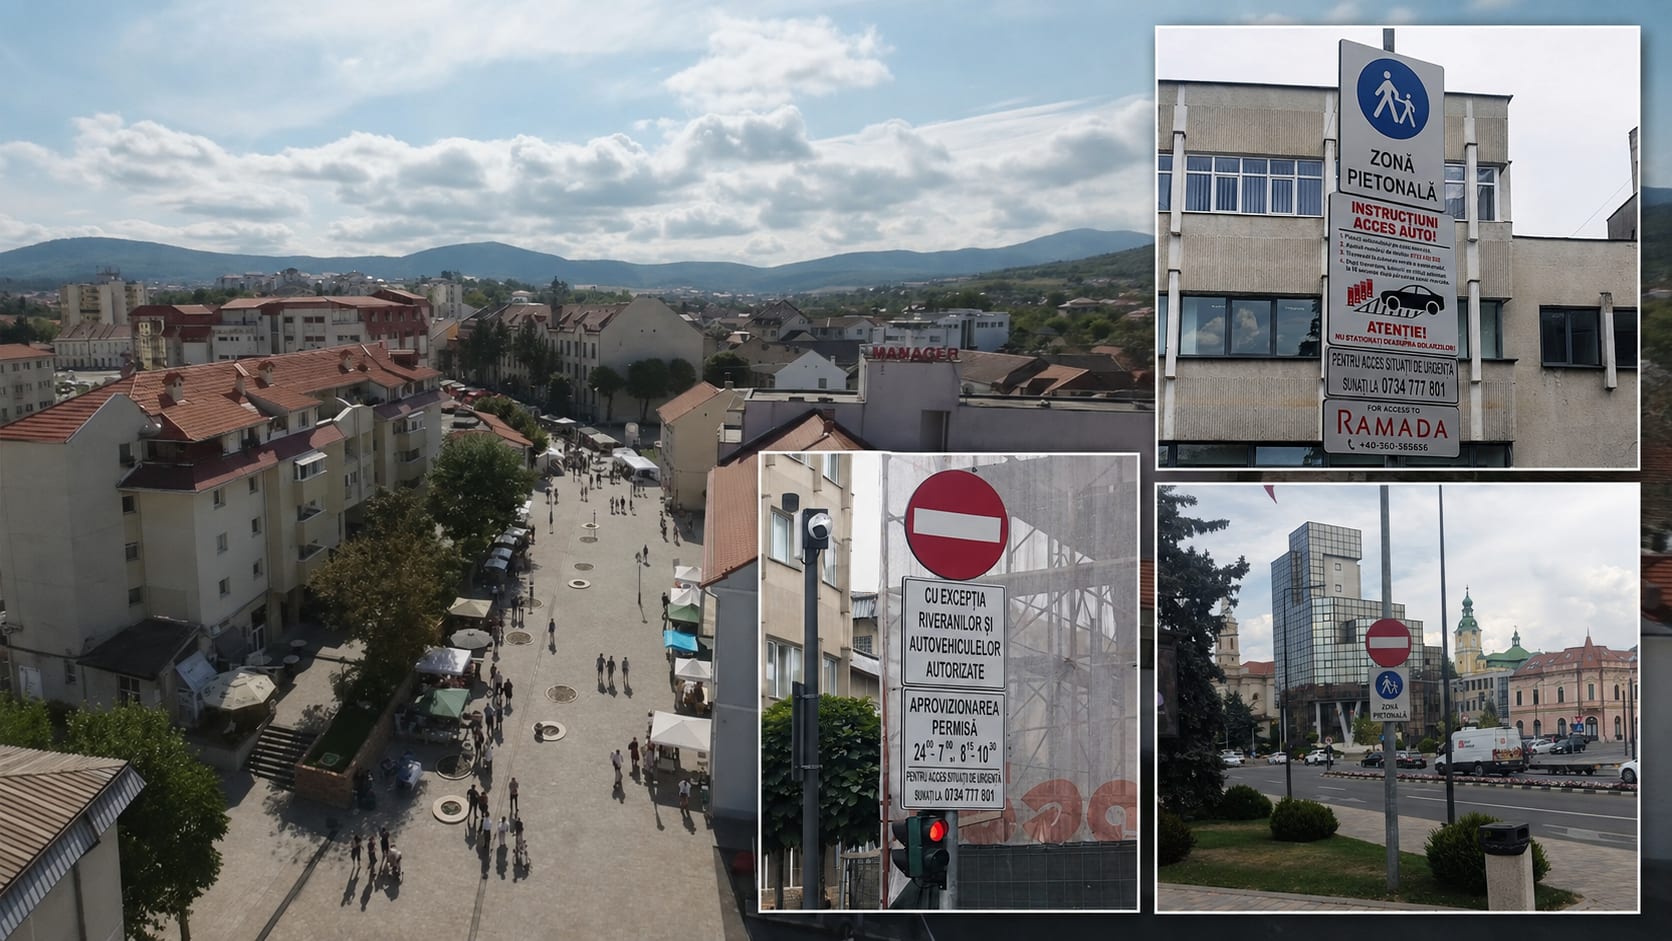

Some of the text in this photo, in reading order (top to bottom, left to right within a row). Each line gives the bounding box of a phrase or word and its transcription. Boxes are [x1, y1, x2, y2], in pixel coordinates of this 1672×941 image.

[1370, 149, 1415, 174] ZONĂ
[1347, 168, 1438, 202] PIETONALĂ
[1353, 216, 1437, 242] ACCES AUTO!
[1366, 320, 1427, 339] ATENȚIE!
[872, 346, 959, 360] MANAGER
[1331, 352, 1361, 368] PENTRU
[1361, 356, 1384, 370] ACCES
[1413, 361, 1423, 374] DE
[1370, 380, 1379, 393] LA
[1381, 378, 1406, 395] 0734
[1408, 379, 1426, 396] 777
[1429, 380, 1446, 397] 801
[1367, 405, 1382, 413] FOR
[1383, 405, 1410, 414] ACCESS
[924, 587, 987, 611] CU EXCEPȚIA
[918, 611, 993, 636] RIVERANILOR ȘI
[909, 636, 1001, 657] AUTOVEHICULELOR
[926, 661, 985, 680] AUTORIZATE
[909, 697, 1000, 717] APROVIZIONAREA
[932, 719, 978, 737] PERMISĂ
[906, 770, 928, 783] PENTRU
[969, 773, 977, 784] DE
[934, 791, 942, 801] LA
[944, 788, 964, 801] 0734
[965, 788, 979, 802] 777
[981, 789, 995, 802] 801
